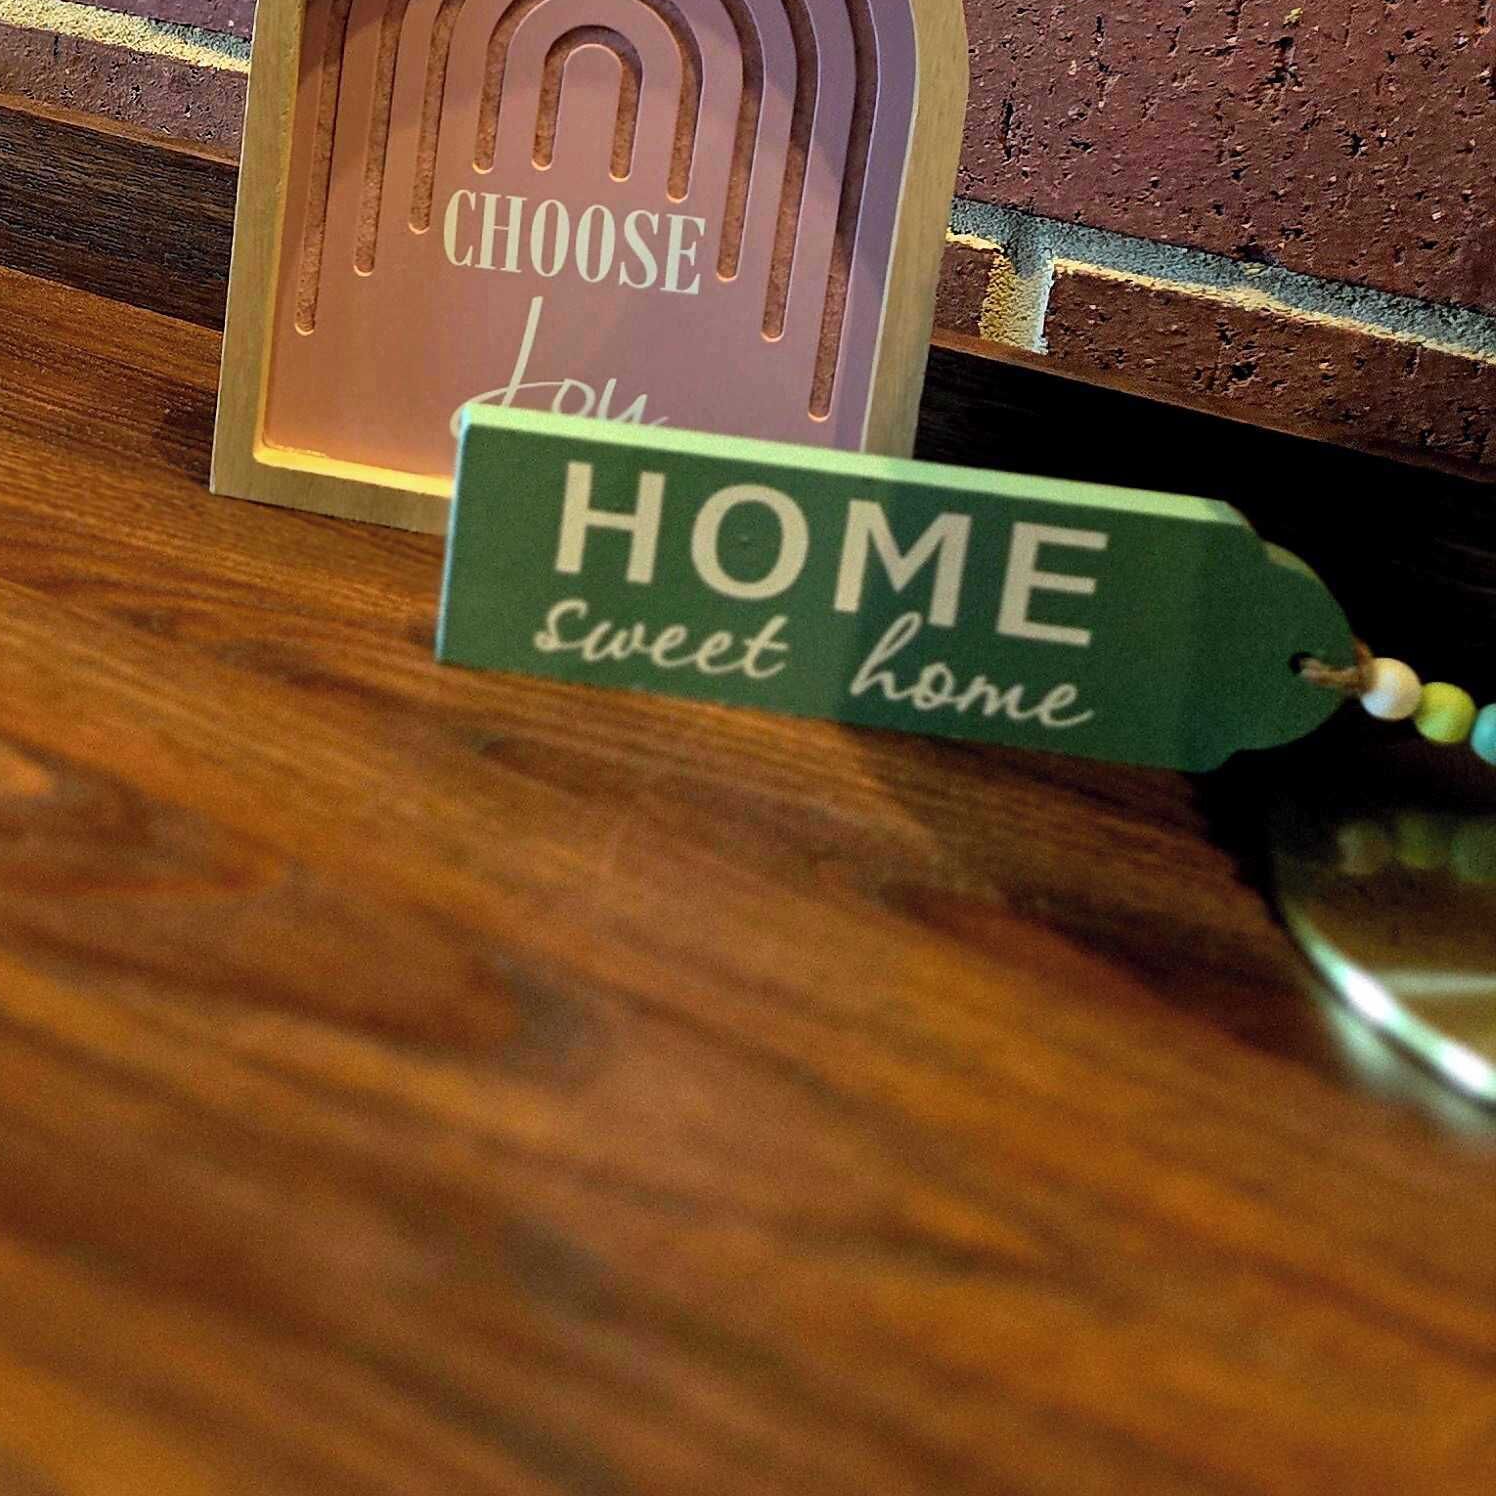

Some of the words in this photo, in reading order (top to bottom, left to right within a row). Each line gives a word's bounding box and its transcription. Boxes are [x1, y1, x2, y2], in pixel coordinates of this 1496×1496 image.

[443, 189, 706, 295] CHOOSE
[555, 461, 1109, 647] HOME
[534, 599, 790, 679] sweet
[851, 612, 1094, 728] home
